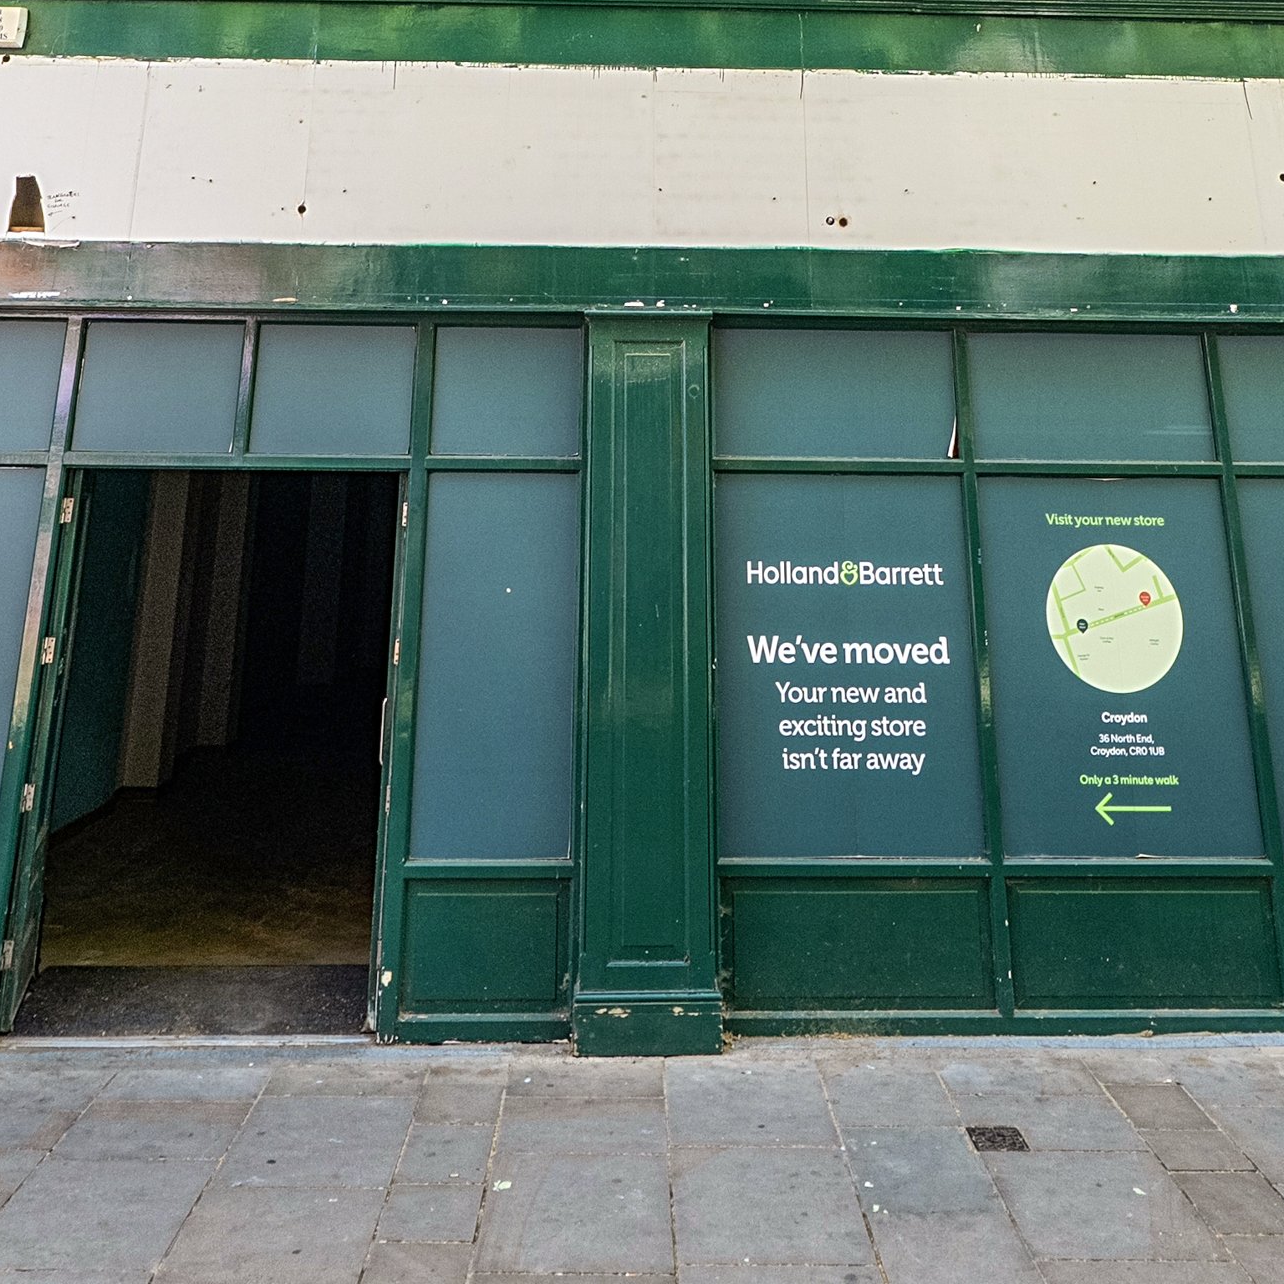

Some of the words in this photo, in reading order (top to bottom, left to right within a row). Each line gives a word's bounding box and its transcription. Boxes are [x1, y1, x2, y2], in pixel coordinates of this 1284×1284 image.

[1045, 513, 1073, 526] Visit
[1075, 515, 1104, 528] your
[1105, 516, 1132, 526] new
[1133, 515, 1165, 527] store
[746, 634, 838, 665] We've
[842, 636, 951, 665] moved
[774, 681, 828, 704] Your
[830, 686, 881, 704] new
[883, 682, 928, 704] and
[1101, 711, 1148, 726] Croydon
[778, 714, 867, 742] exciting
[870, 716, 927, 737] store
[1098, 733, 1111, 744] 36
[1110, 733, 1136, 744] North
[1136, 733, 1155, 745] End,
[1090, 746, 1128, 758] Croydon,
[1148, 746, 1165, 756] 1UB
[782, 747, 829, 770] isn't
[831, 747, 863, 770] far
[866, 752, 926, 776] away
[1079, 773, 1104, 788] Only
[1104, 777, 1112, 785] a
[1112, 774, 1120, 785] 3
[1120, 773, 1154, 786] minute
[1154, 774, 1180, 786] walk
